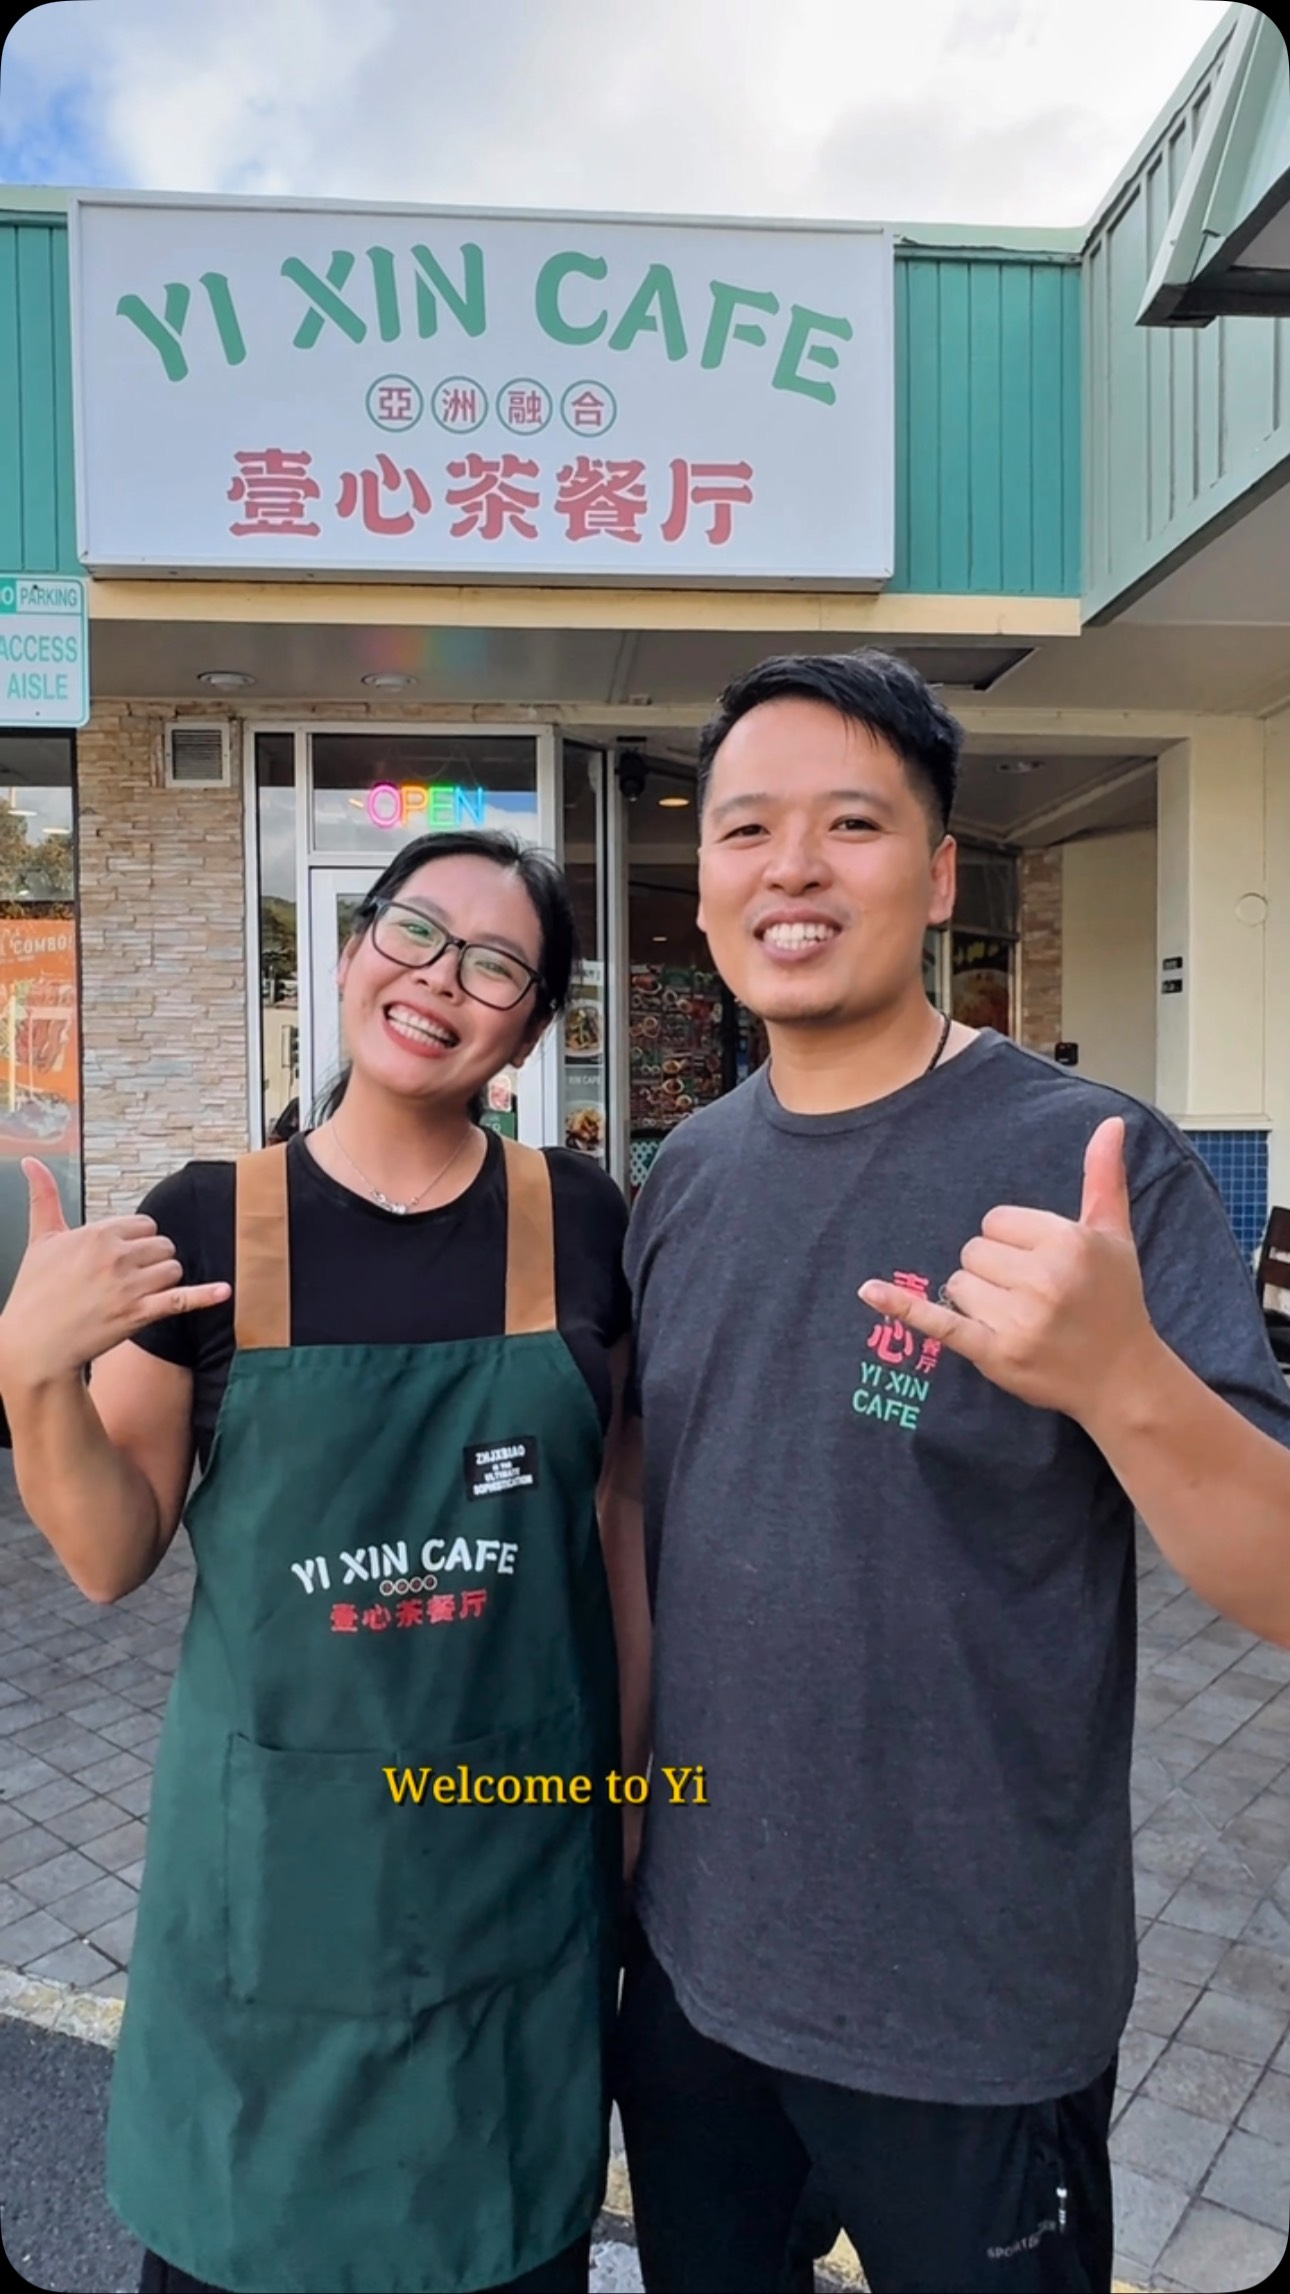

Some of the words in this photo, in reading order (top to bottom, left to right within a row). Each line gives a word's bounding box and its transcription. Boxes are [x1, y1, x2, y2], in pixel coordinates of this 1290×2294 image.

[116, 271, 248, 383] YI
[281, 243, 487, 350] XIN
[535, 250, 853, 406] CAFE
[374, 382, 609, 430] 亞洲融合
[226, 447, 755, 545] 壹心茶餐厅
[20, 587, 78, 607] PARKING
[0, 634, 78, 663] ACCESS
[7, 672, 68, 700] AISLE
[368, 783, 486, 828] OPEN
[861, 1361, 882, 1386] YI
[885, 1371, 929, 1402] XIN
[852, 1389, 921, 1430] CAFE
[291, 1556, 331, 1594] YI
[339, 1540, 409, 1585] XIN
[421, 1536, 518, 1574] CAFE
